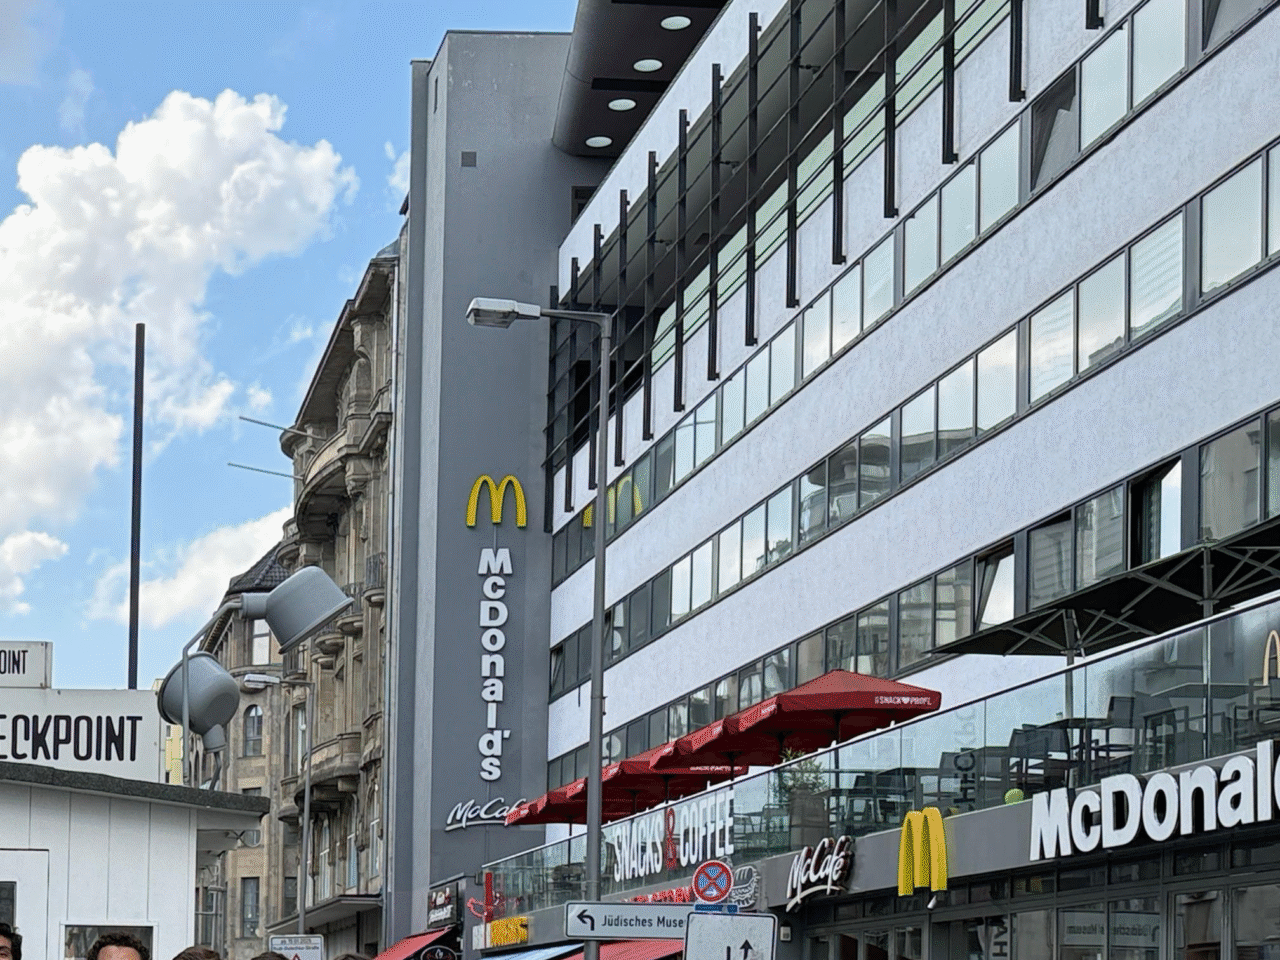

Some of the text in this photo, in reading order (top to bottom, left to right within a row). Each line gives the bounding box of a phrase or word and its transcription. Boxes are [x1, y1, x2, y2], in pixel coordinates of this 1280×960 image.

[478, 548, 513, 780] McDonald's
[613, 789, 735, 883] SNACKS & COFFEE
[1029, 738, 1280, 862] McDonal
[787, 835, 854, 896] McCafé
[601, 914, 685, 928] Jüdisches Muse
